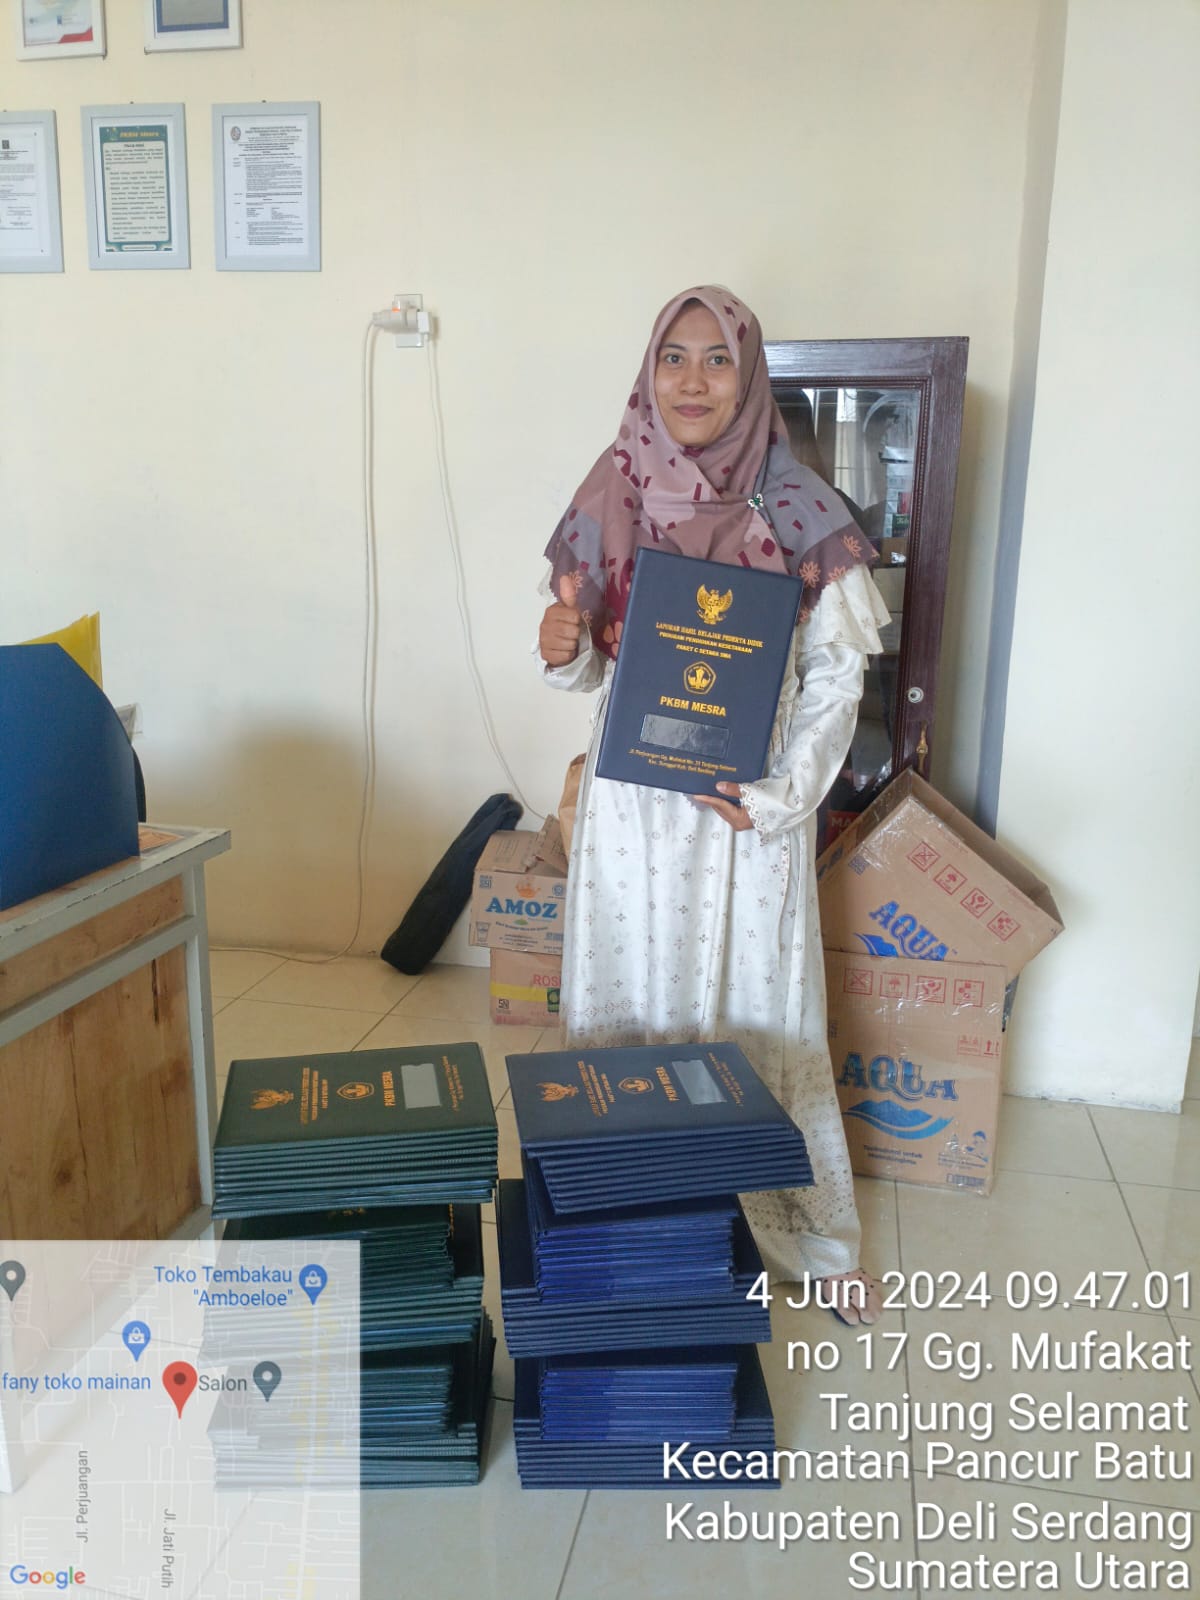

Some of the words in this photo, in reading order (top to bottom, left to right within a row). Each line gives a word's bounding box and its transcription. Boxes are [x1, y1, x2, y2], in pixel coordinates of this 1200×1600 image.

[659, 695, 689, 710] PKBM
[691, 703, 726, 717] MESRA
[486, 897, 558, 919] AMOZ
[868, 900, 949, 960] AQUA
[837, 1052, 959, 1102] AQUA
